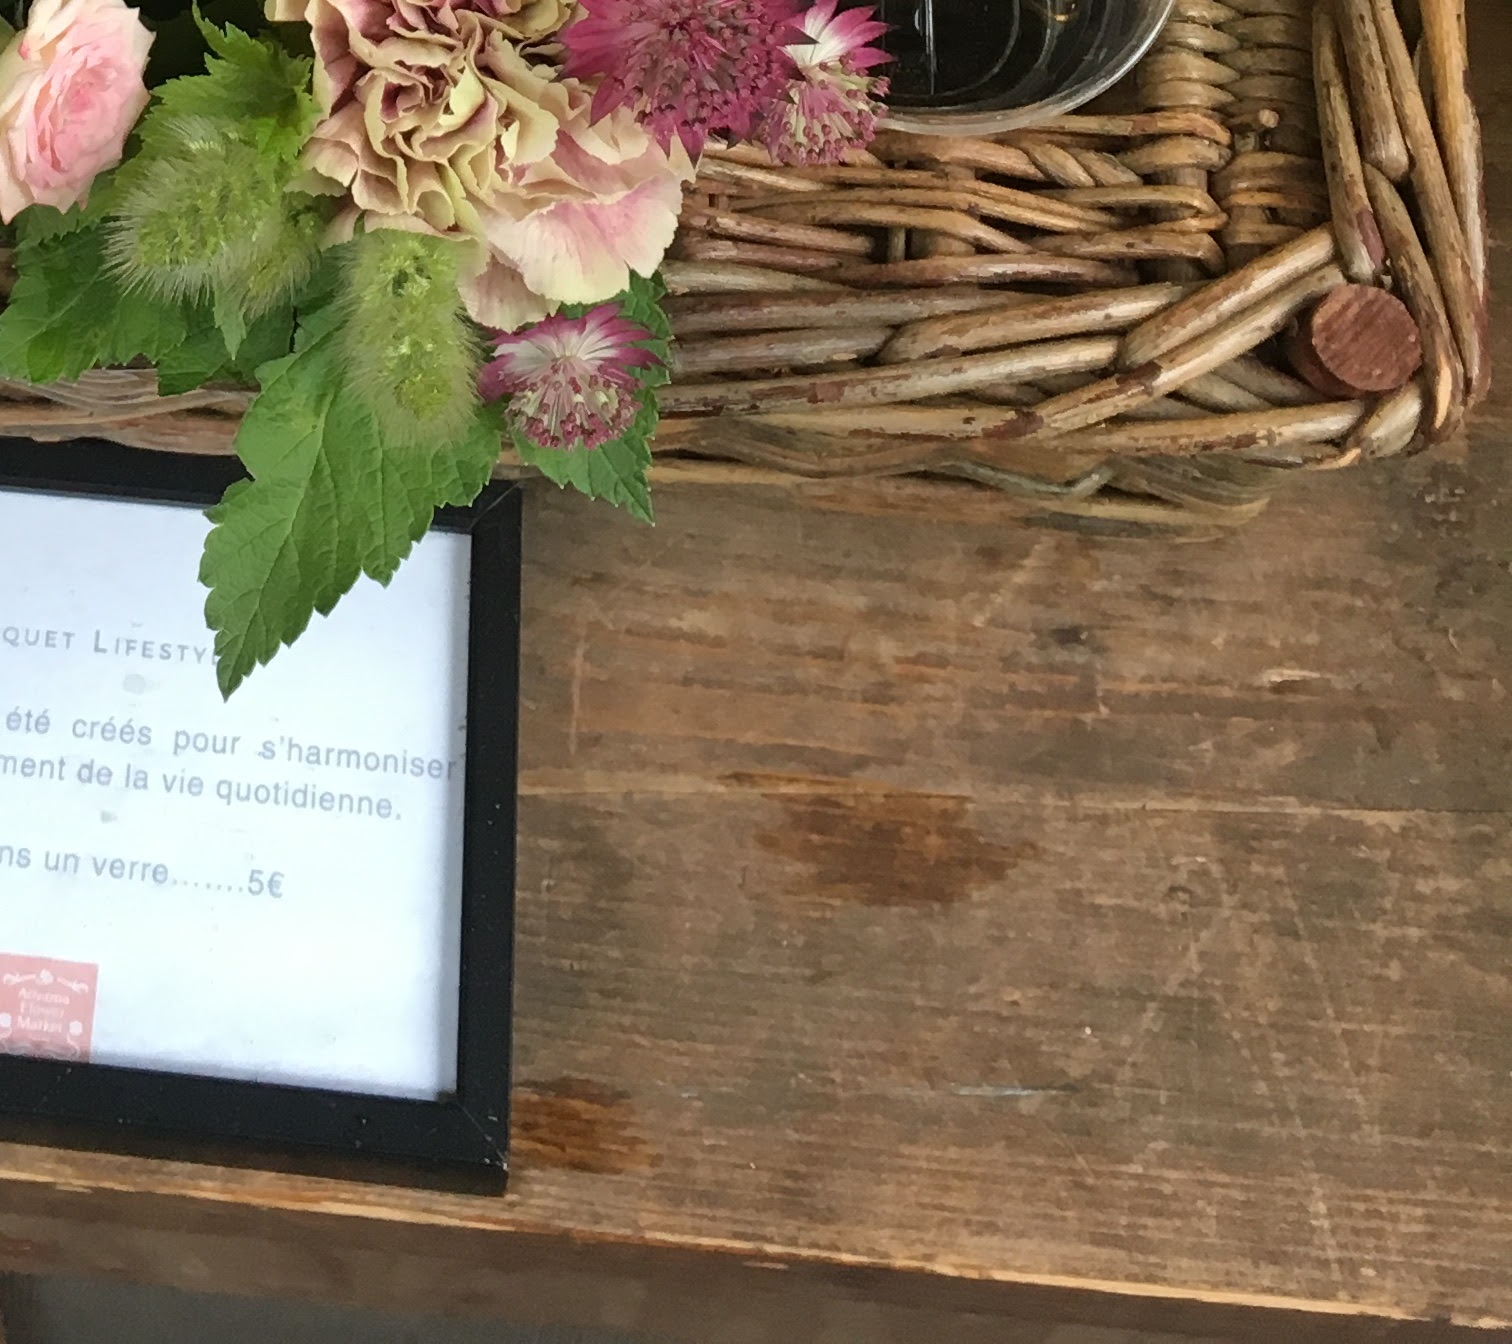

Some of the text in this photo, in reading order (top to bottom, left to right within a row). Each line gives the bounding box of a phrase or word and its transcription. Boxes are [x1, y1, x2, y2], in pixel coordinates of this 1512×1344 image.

[92, 629, 219, 666] LIFESTY
[5, 706, 51, 736] été
[71, 716, 152, 746] créés
[172, 729, 241, 756] pour
[76, 759, 113, 787] de
[125, 764, 149, 790] la
[163, 769, 204, 797] vie
[215, 777, 402, 821] quotidienne.
[44, 849, 80, 876] un
